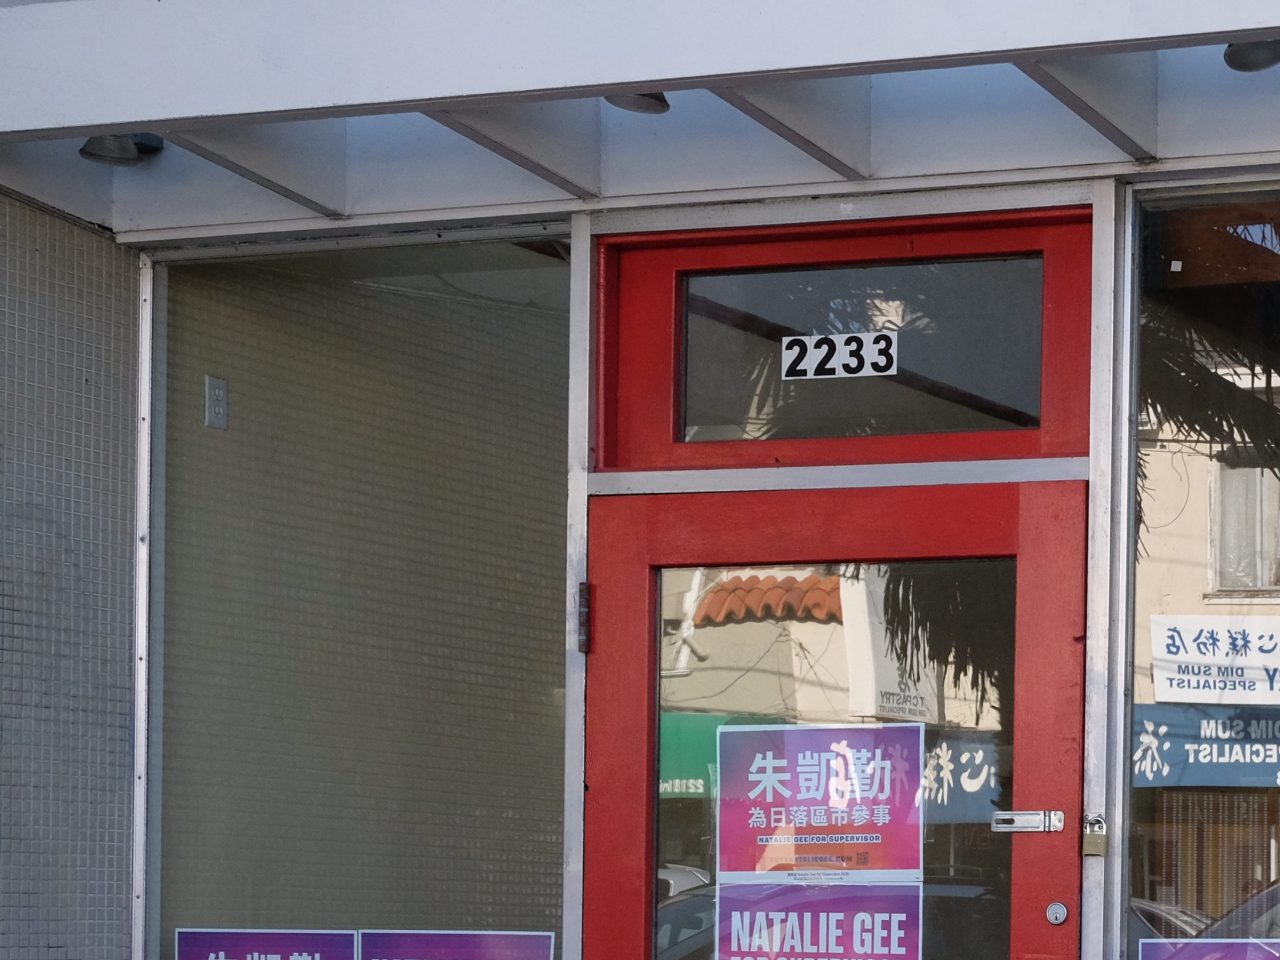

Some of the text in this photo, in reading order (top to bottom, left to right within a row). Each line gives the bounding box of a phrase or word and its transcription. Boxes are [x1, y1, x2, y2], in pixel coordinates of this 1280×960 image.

[784, 334, 894, 378] 2233
[758, 836, 791, 844] NATALIE
[793, 836, 809, 844] GEE
[828, 834, 881, 843] SUPERVISOR
[731, 911, 906, 954] NATALIE GEE
